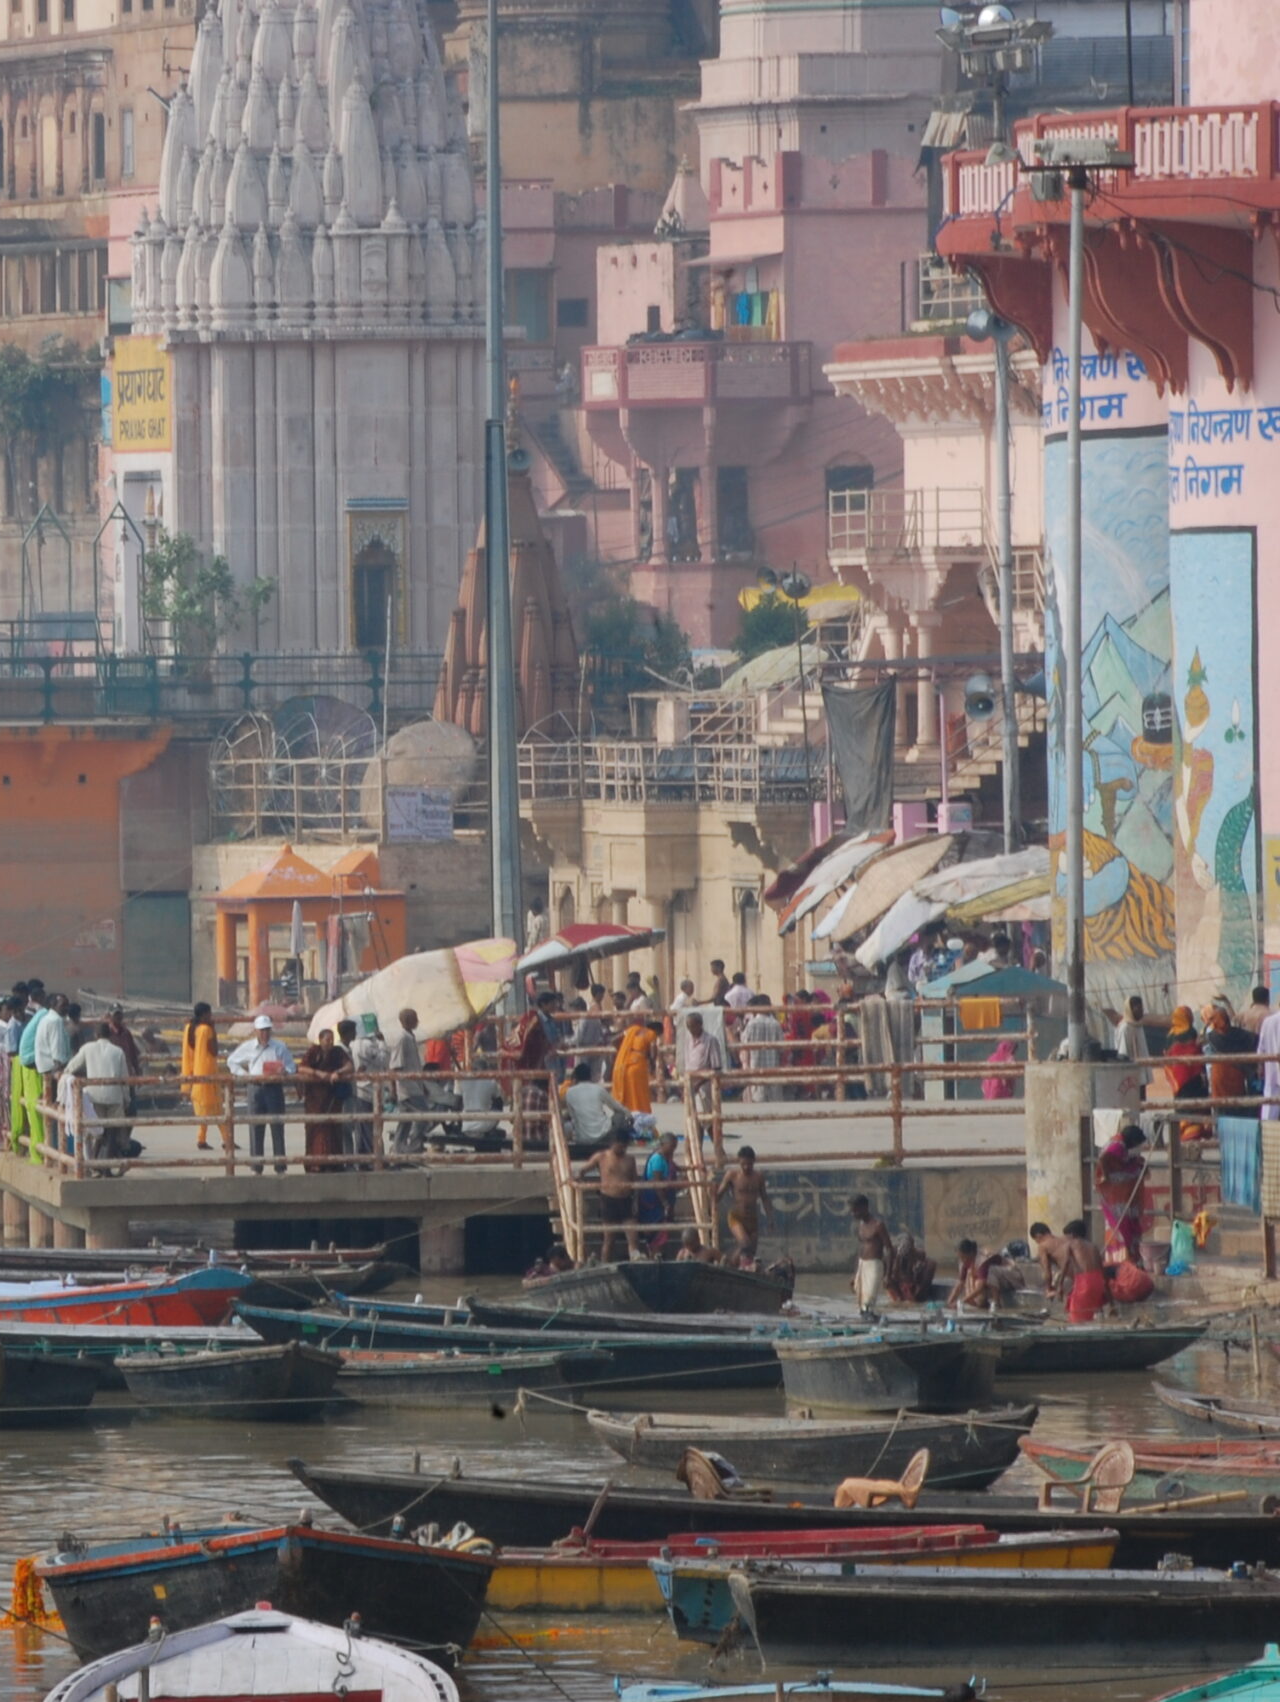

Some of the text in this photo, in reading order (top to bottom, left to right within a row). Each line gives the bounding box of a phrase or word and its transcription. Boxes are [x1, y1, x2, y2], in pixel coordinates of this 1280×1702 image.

[120, 417, 166, 441] PRAYAG GHAT
[1184, 456, 1244, 502] निगम
